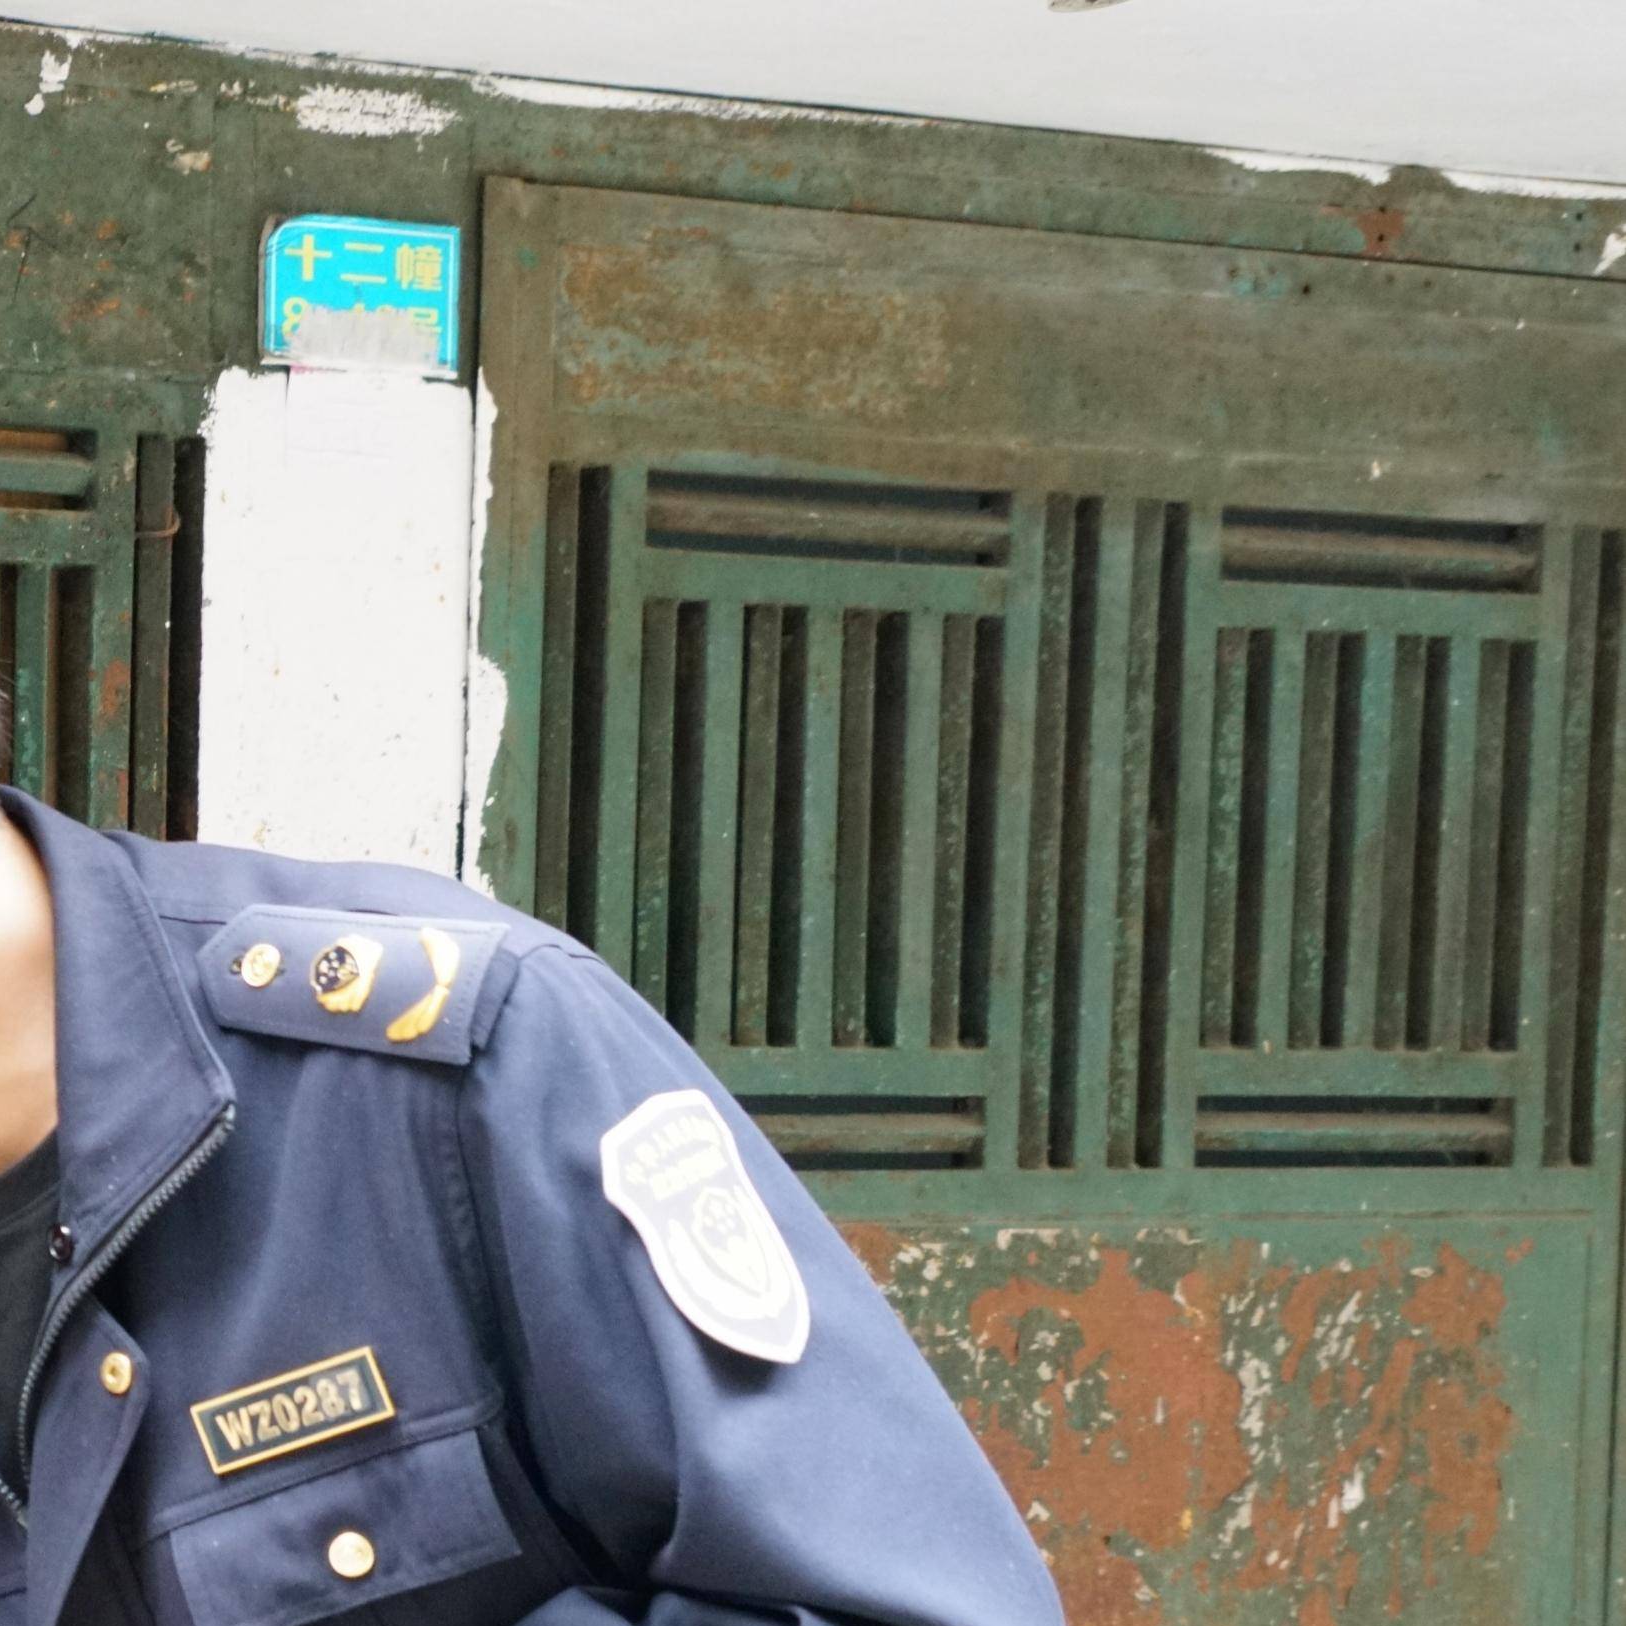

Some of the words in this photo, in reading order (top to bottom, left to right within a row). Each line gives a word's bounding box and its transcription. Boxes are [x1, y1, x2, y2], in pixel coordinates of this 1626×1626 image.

[284, 233, 443, 292] 十二幢
[213, 1367, 366, 1452] WZ0287
